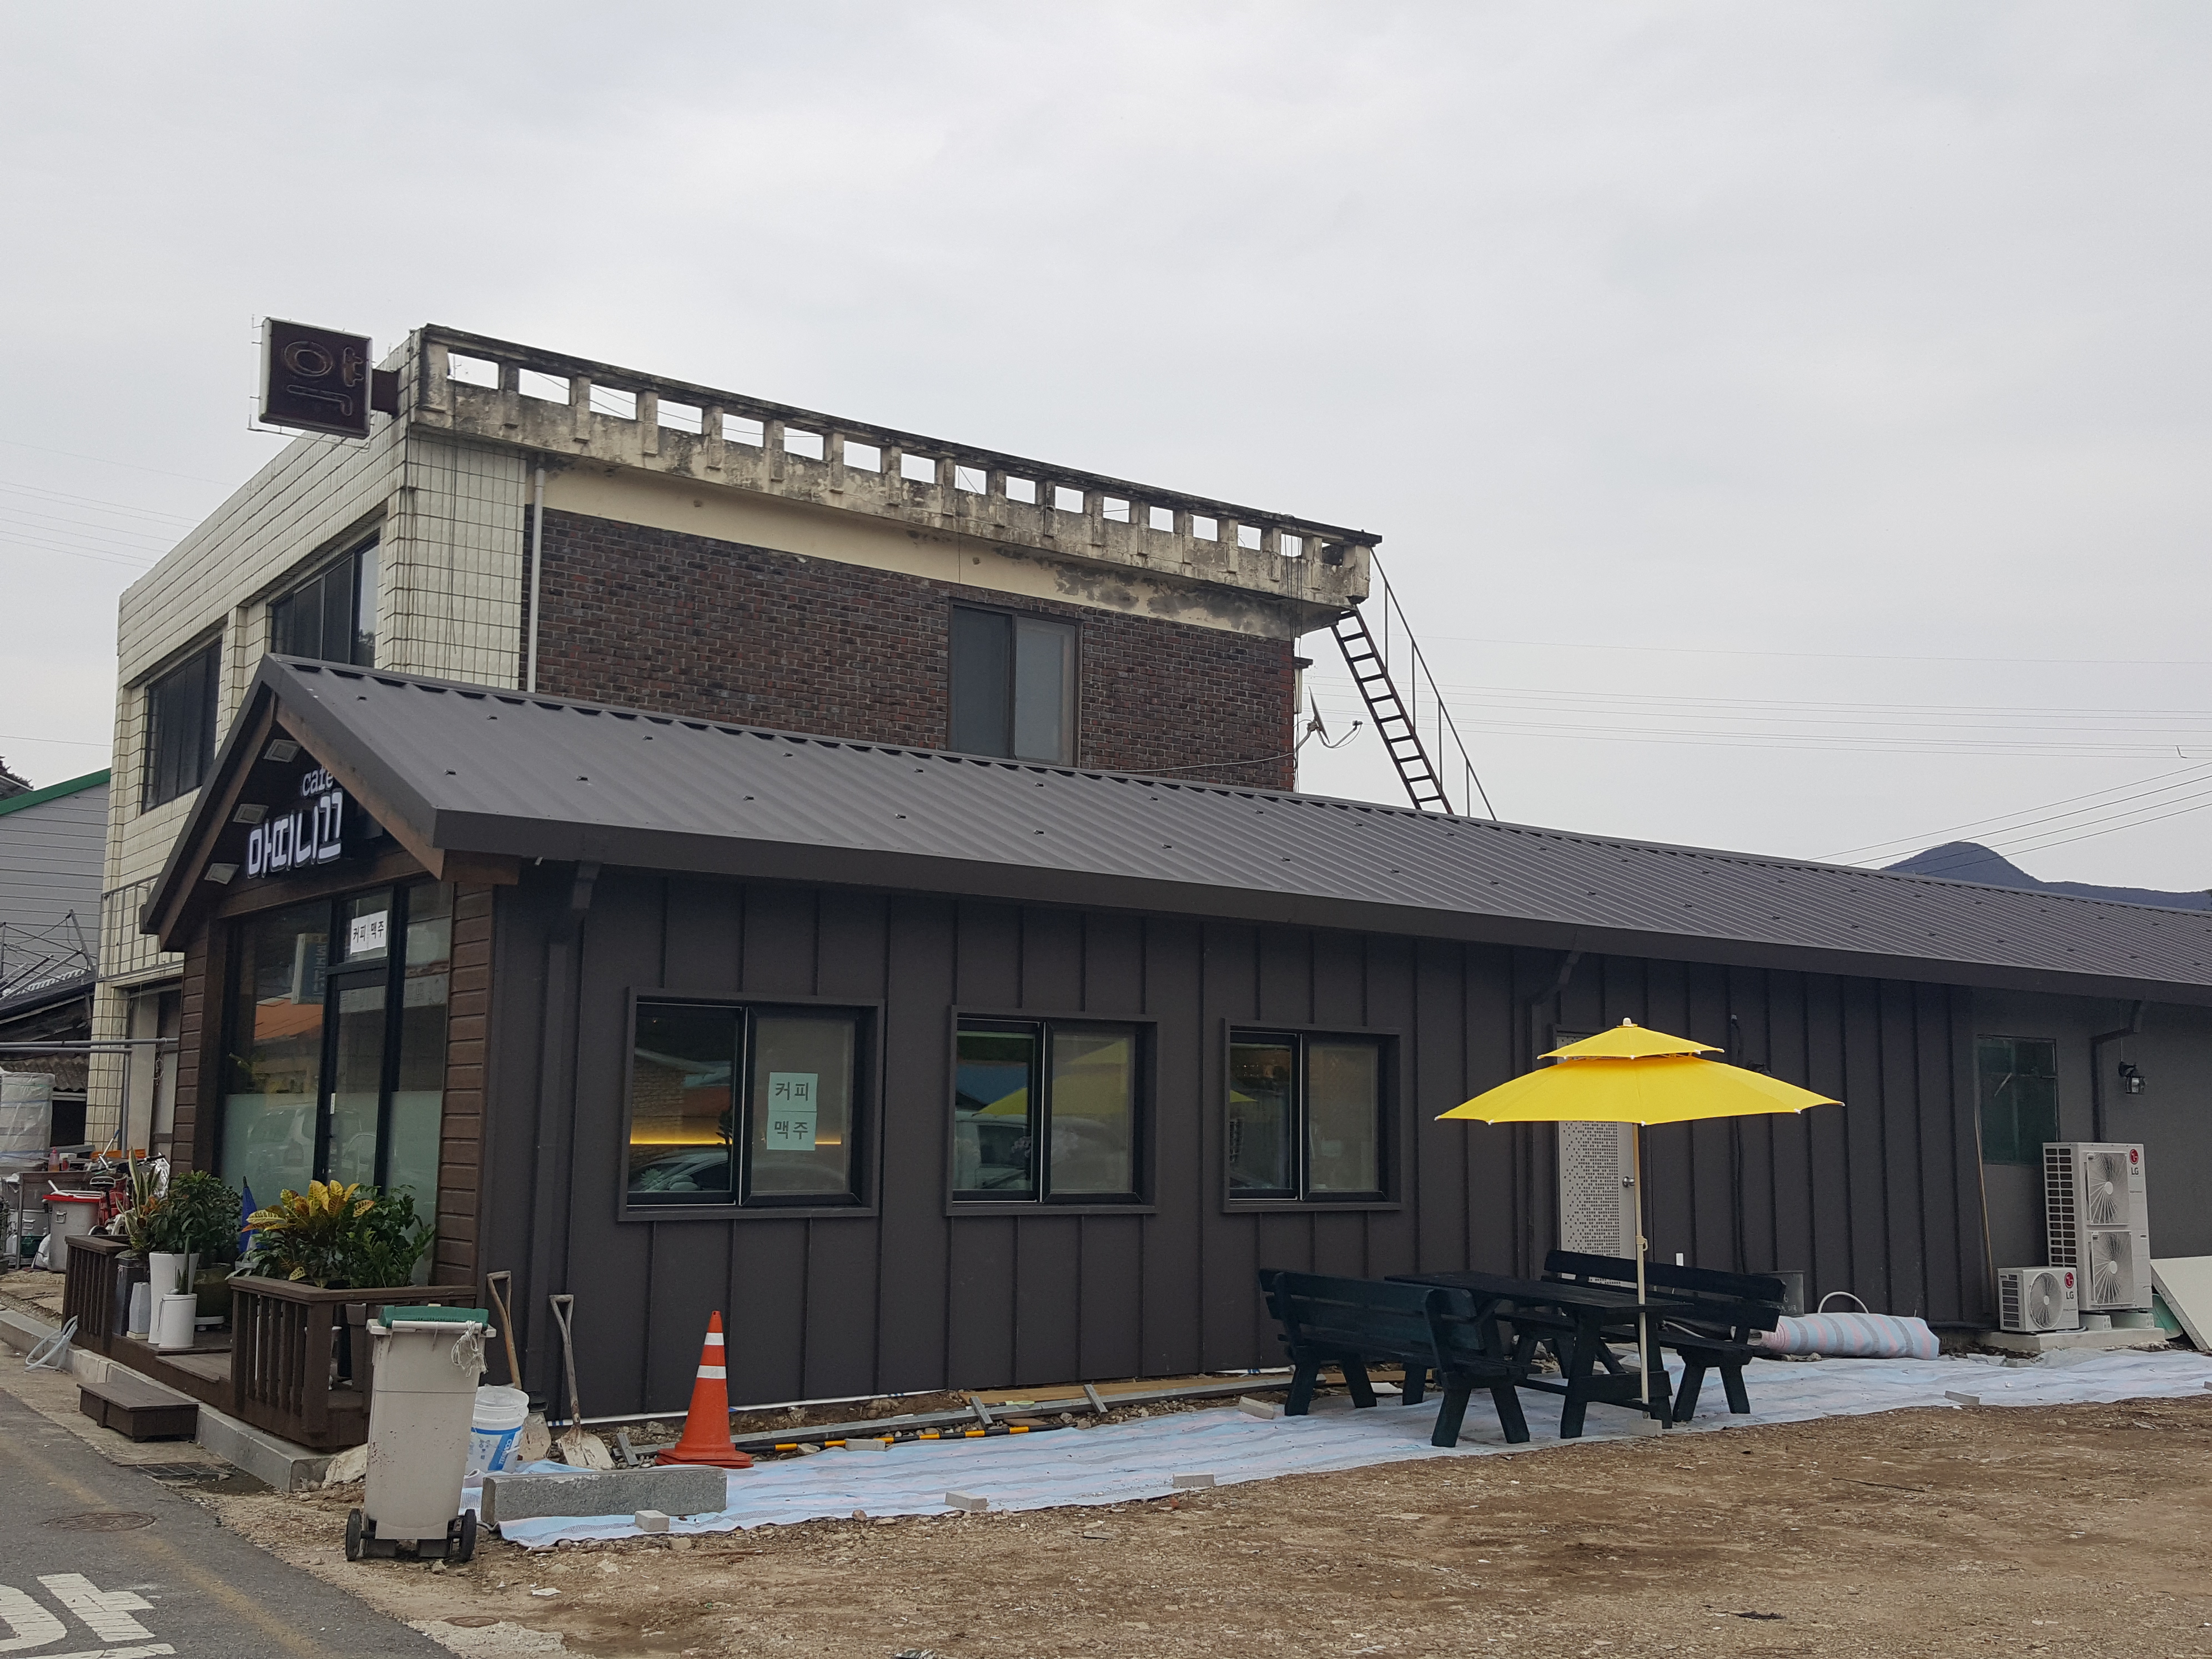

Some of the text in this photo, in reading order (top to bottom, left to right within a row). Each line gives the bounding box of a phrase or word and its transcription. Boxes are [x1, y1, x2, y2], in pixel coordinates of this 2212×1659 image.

[248, 791, 344, 876] 마띠니끄
[353, 921, 384, 943] 커피 맥주
[775, 1082, 809, 1101] 커피
[774, 1120, 808, 1140] 맥주
[2131, 1167, 2139, 1175] LG
[2066, 1291, 2074, 1300] LG
